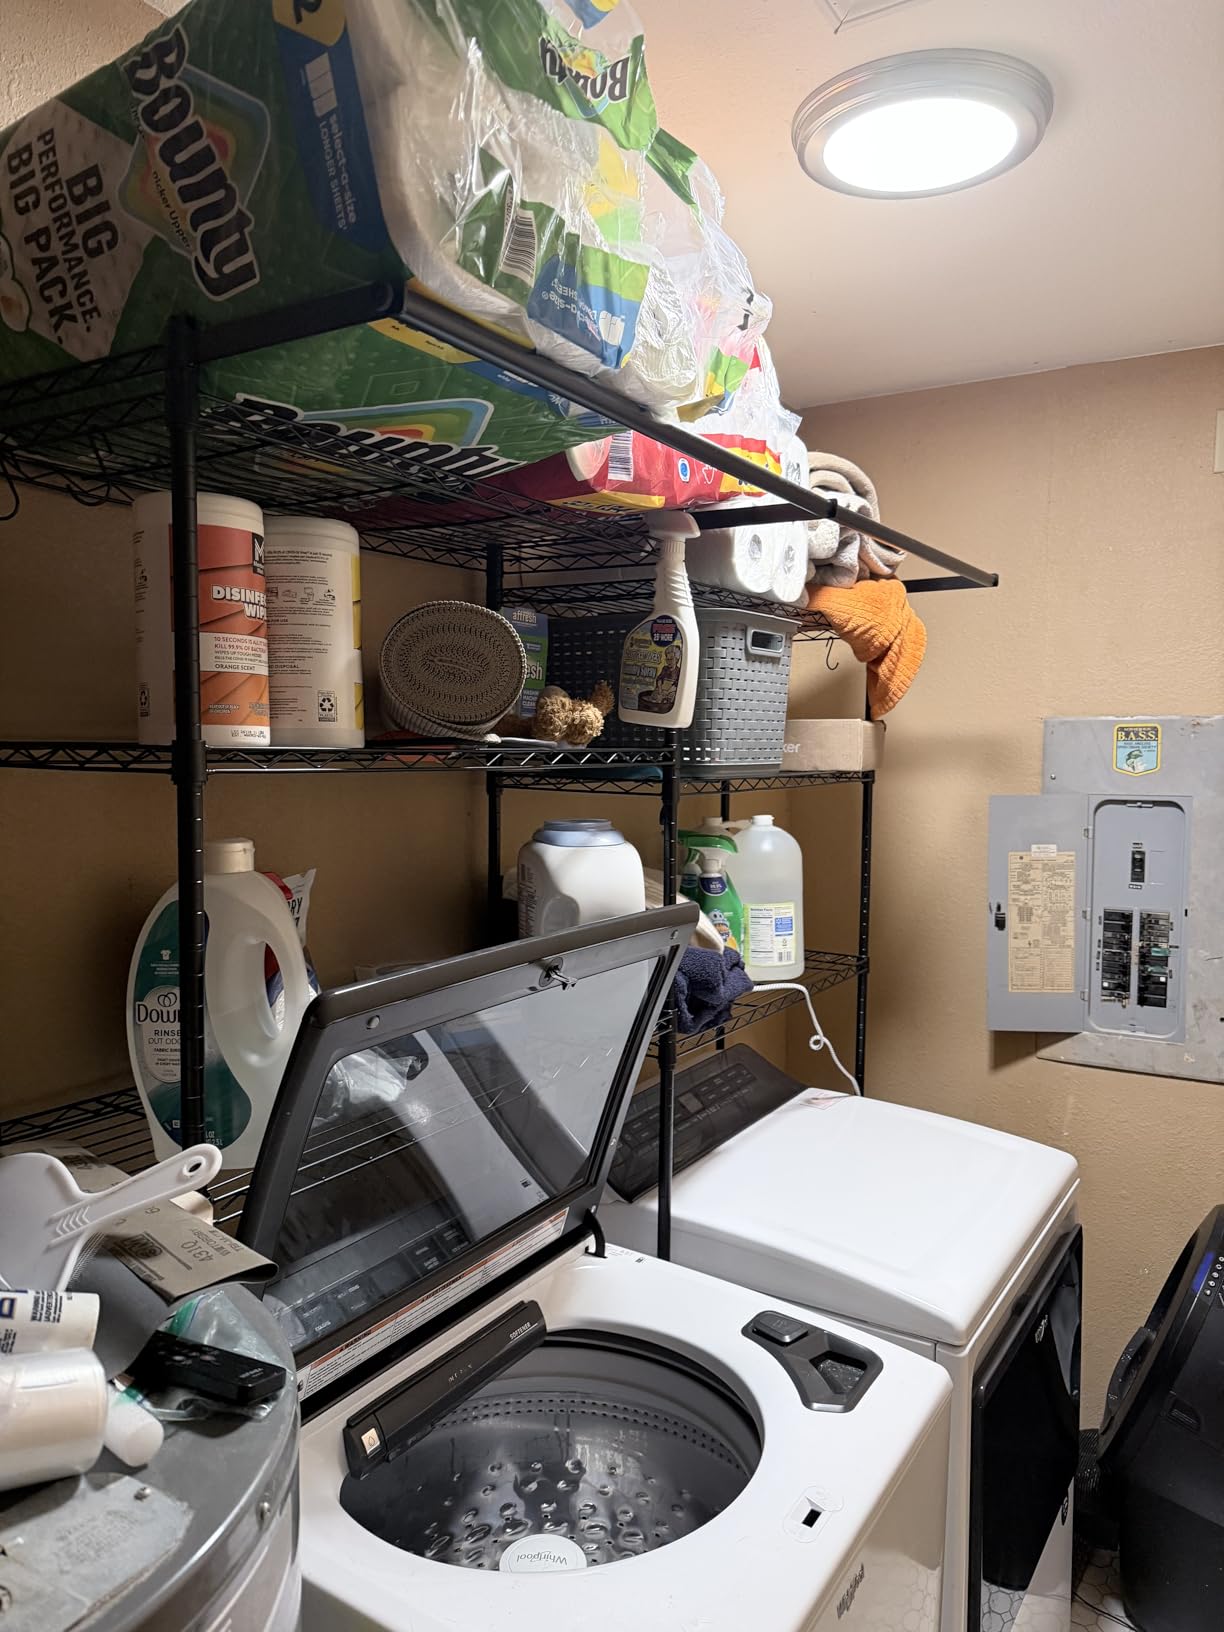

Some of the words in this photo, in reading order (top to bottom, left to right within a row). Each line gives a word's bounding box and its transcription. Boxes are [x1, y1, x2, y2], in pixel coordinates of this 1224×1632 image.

[119, 25, 260, 300] Bounty
[317, 120, 339, 180] LONGER
[329, 112, 357, 224] select-a-size
[36, 127, 101, 333] PERFORMANCE.
[66, 163, 119, 259] BIG
[7, 142, 41, 217] BIG
[24, 226, 80, 346] PACK.
[512, 610, 537, 624] affresh
[222, 637, 248, 645] SECONDS
[1118, 731, 1158, 741] B.A.S.S.
[148, 1037, 163, 1045] OUT
[508, 1321, 532, 1341] SOFTENER
[516, 1550, 568, 1566] Whirlpool
